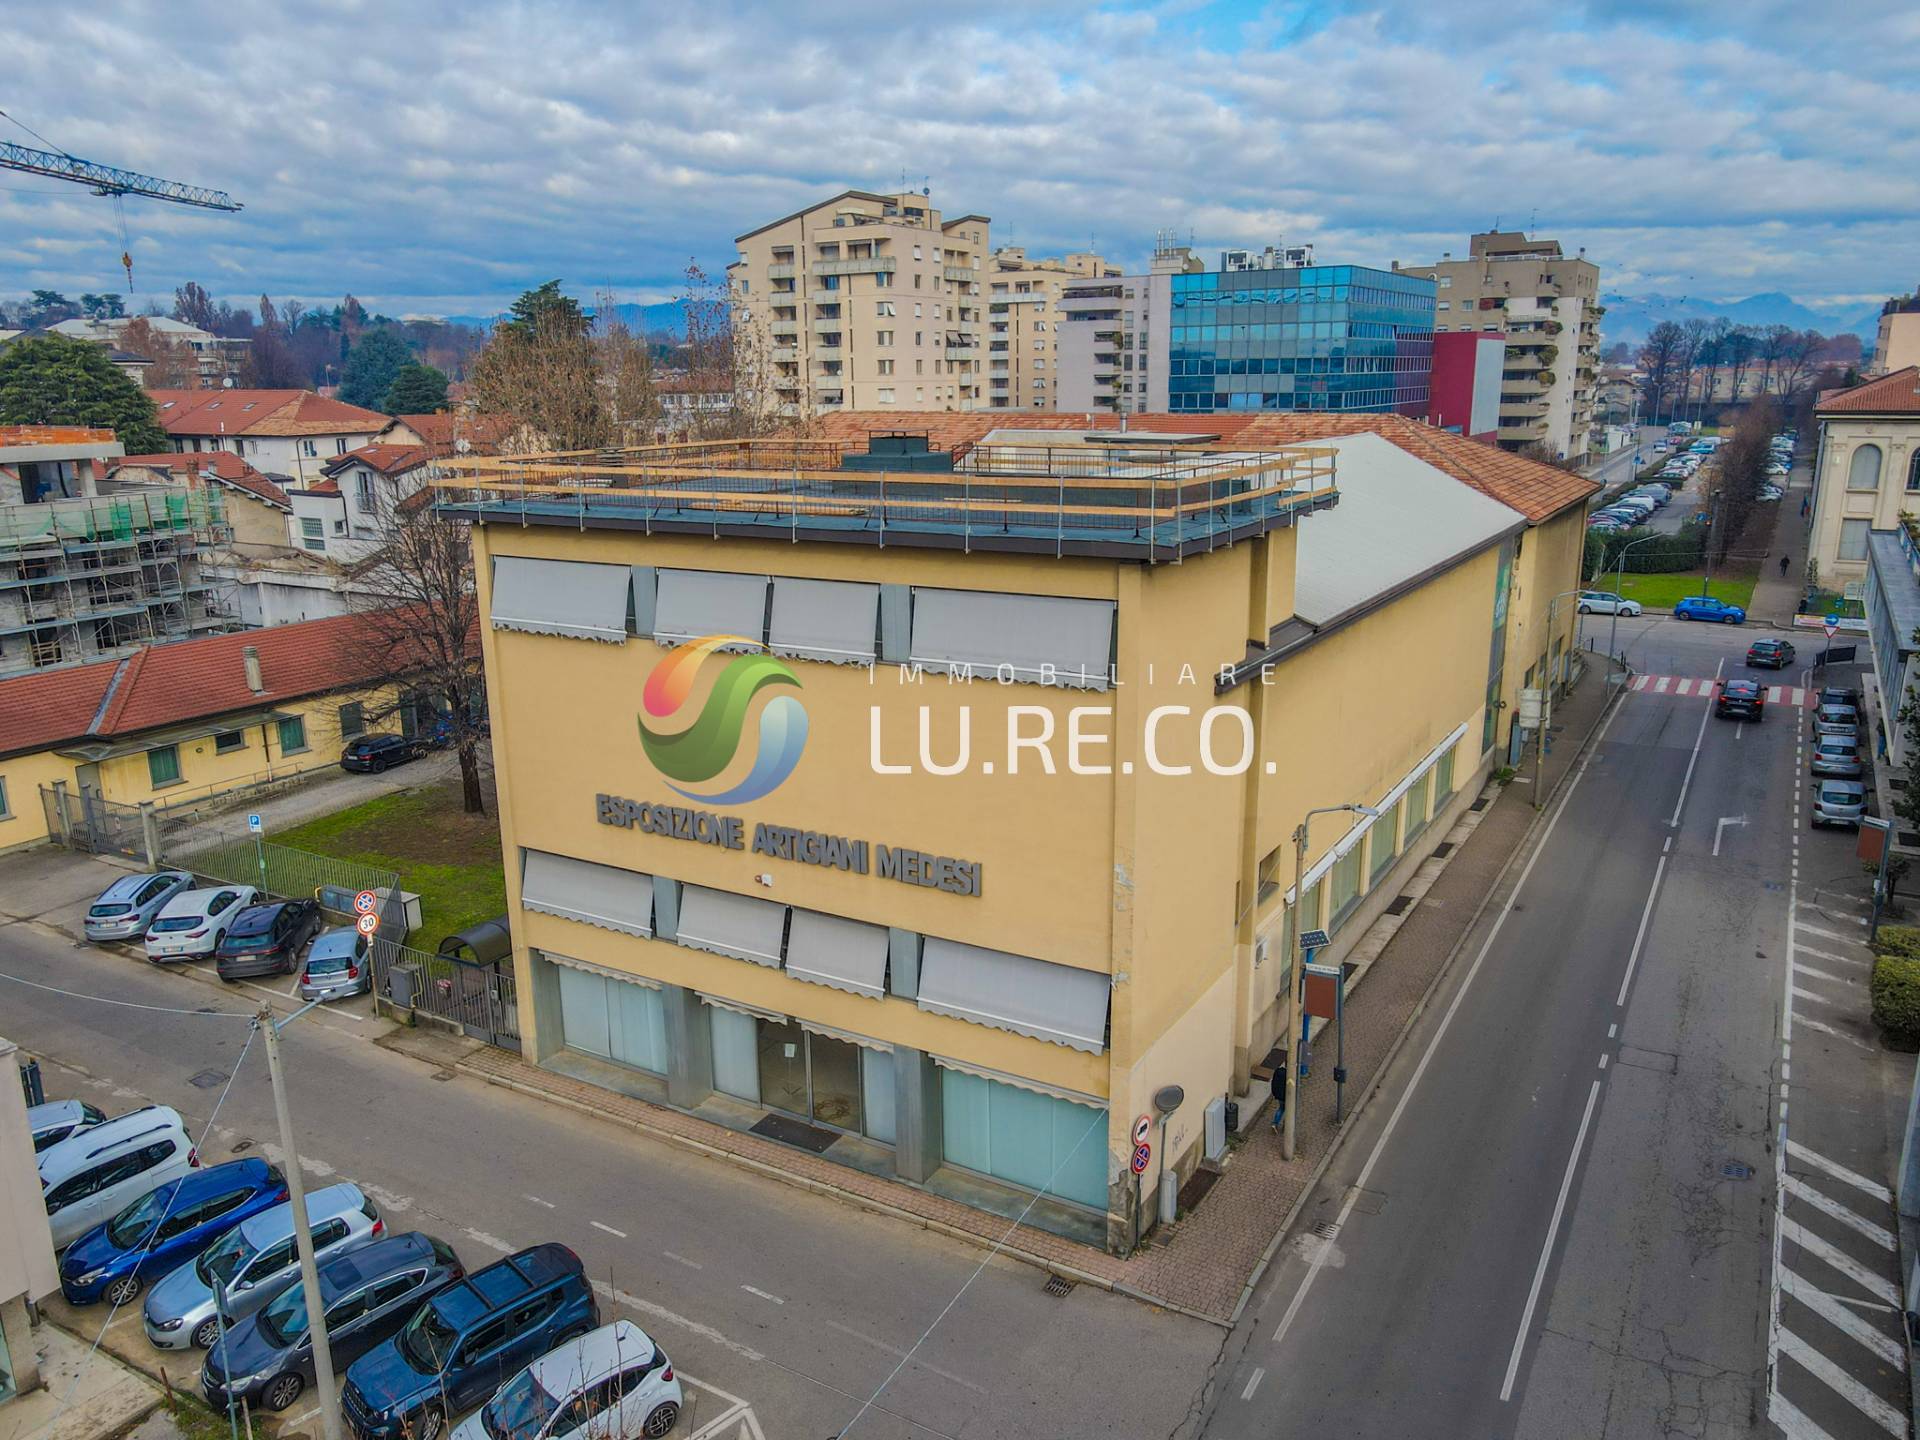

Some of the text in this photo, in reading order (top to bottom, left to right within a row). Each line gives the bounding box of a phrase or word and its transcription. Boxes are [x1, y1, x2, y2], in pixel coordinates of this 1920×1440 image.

[596, 793, 982, 897] ESPOSIZIONE ARTIGIANI MEDESI
[362, 917, 374, 929] 30
